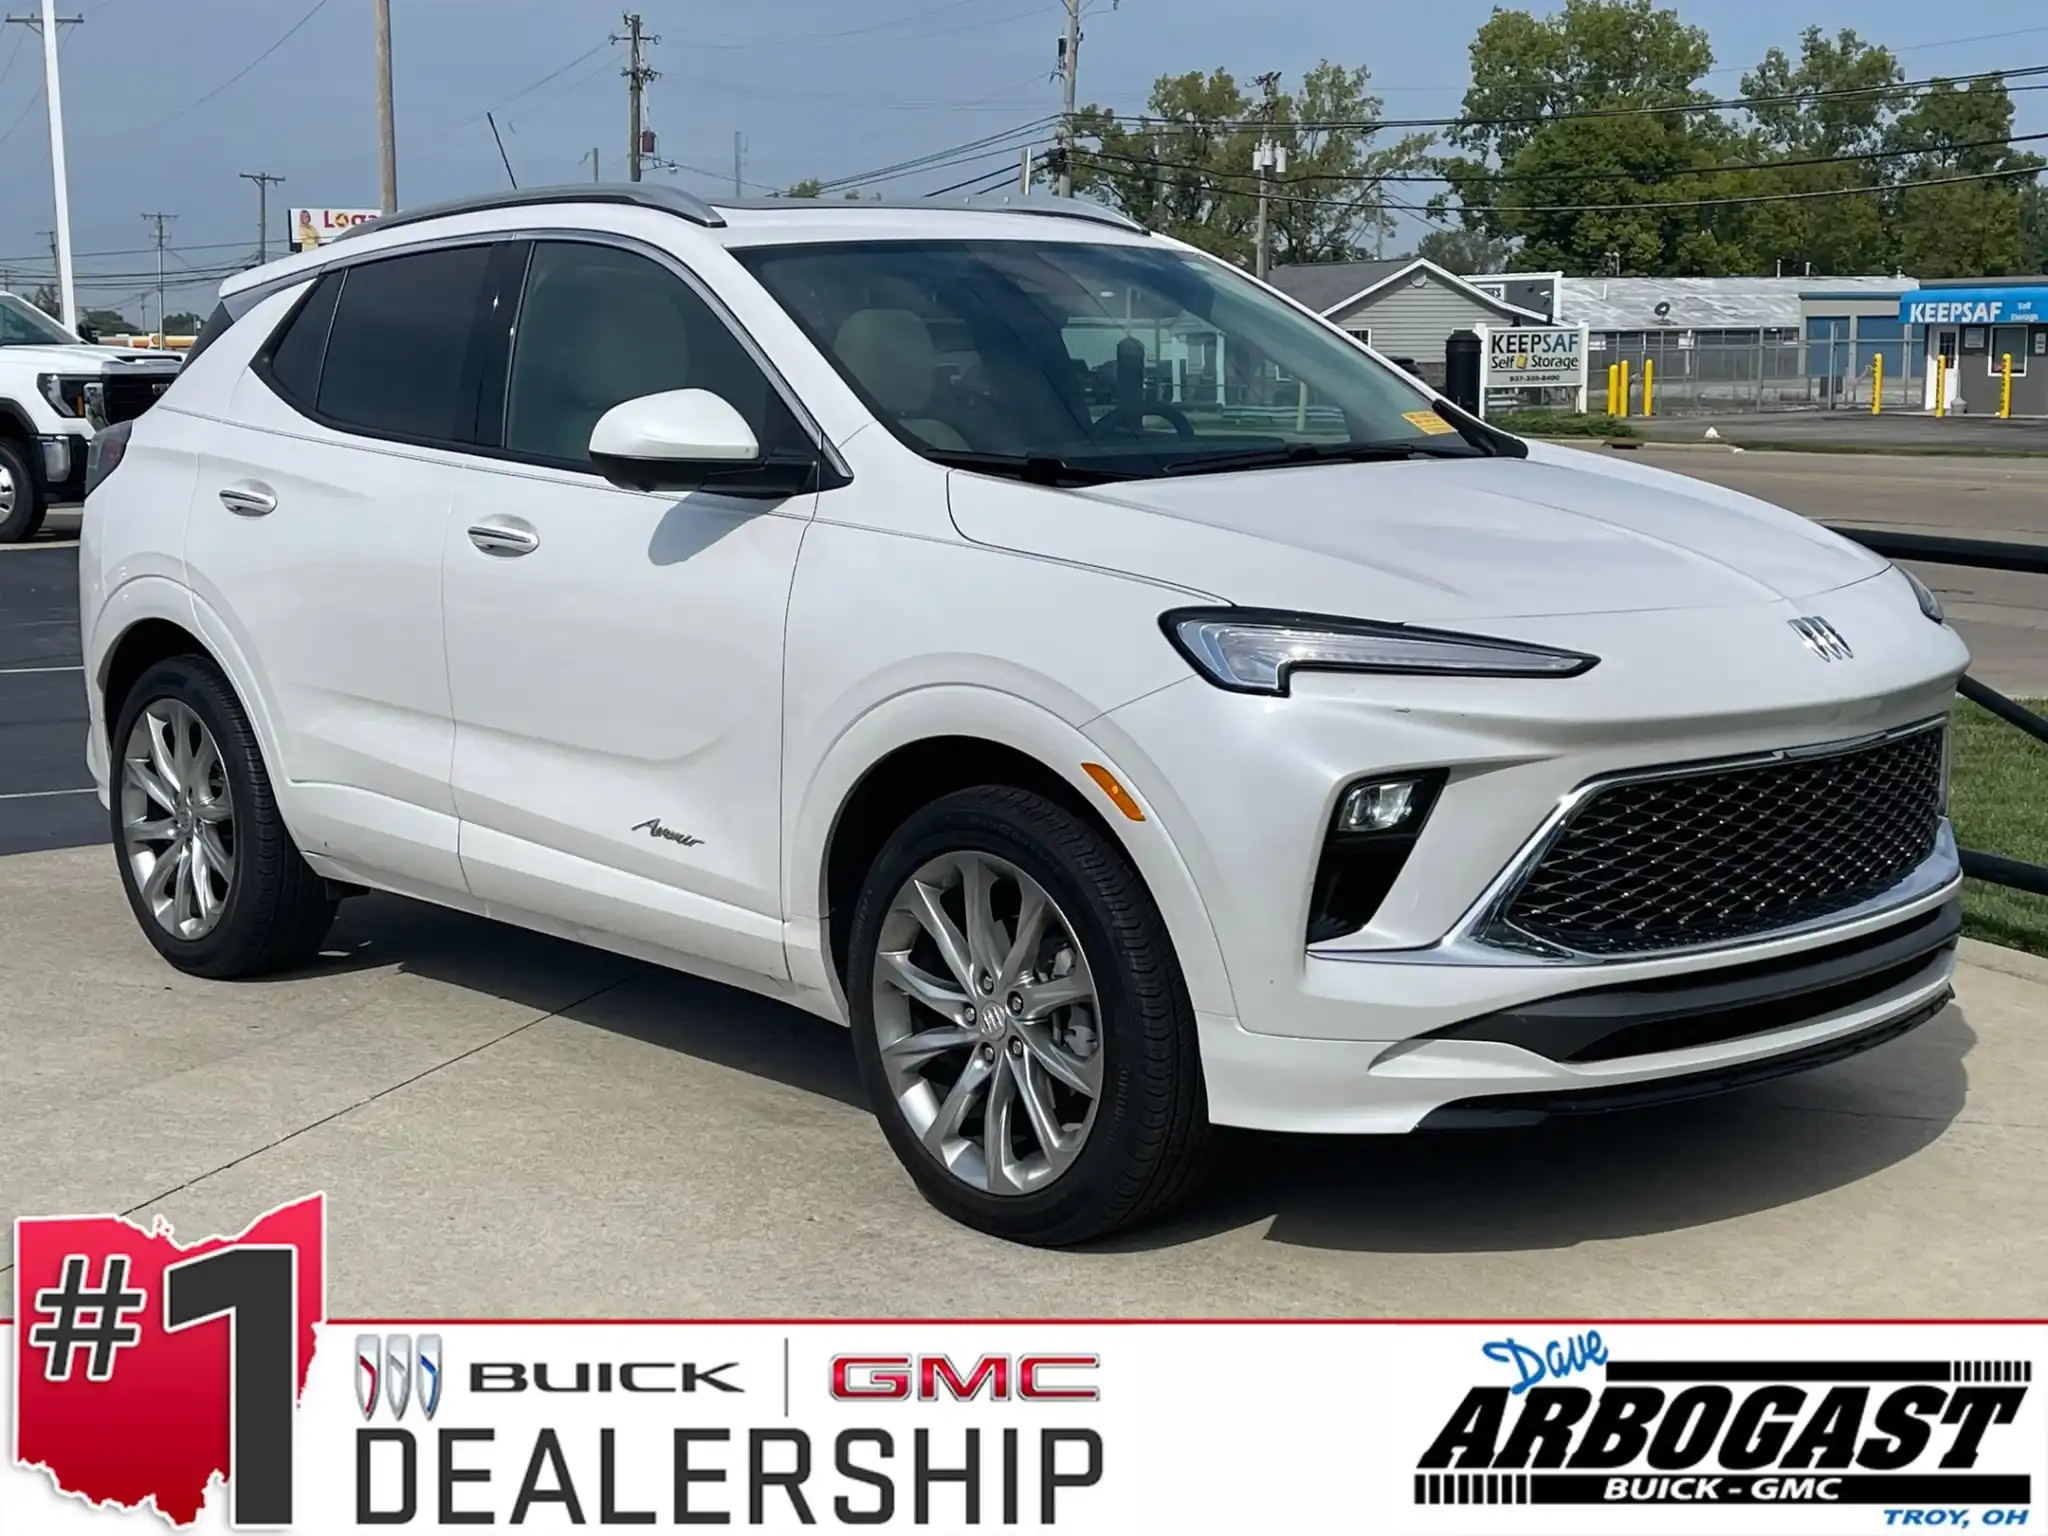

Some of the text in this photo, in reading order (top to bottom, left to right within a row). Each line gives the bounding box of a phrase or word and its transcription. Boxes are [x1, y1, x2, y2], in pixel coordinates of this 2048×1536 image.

[1910, 302, 2003, 323] KEEPSAF
[1491, 333, 1579, 353] KEEPSAF
[1491, 354, 1579, 371] Self Storage
